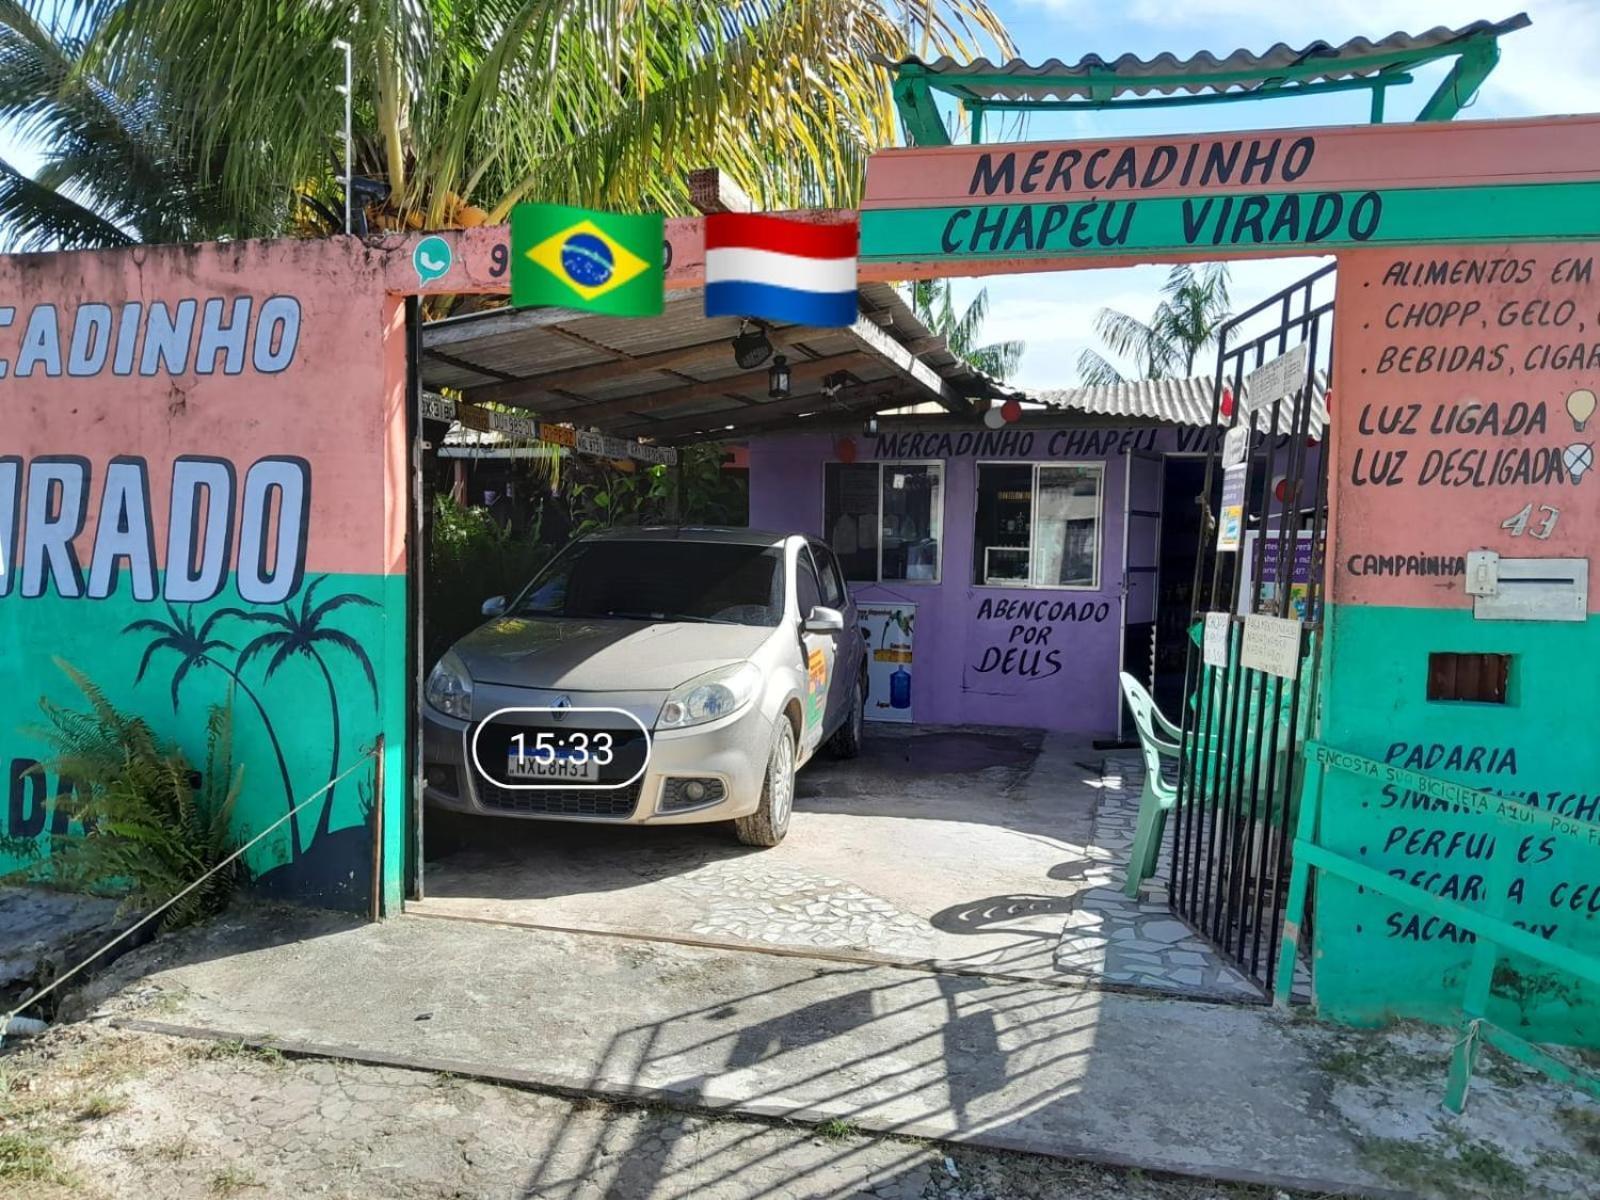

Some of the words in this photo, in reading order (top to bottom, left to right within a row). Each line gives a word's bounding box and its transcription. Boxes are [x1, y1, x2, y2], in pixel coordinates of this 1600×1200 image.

[968, 136, 1315, 196] MERCADINHO
[941, 197, 1137, 253] CHAPÉU
[1181, 191, 1382, 245] VIRADO
[1382, 258, 1536, 288] ALIMENTOS
[1551, 257, 1595, 285] EM
[1385, 300, 1488, 330] CHOPP,
[1377, 344, 1516, 376] BEBIDAS,
[1358, 403, 1422, 436] LUZ
[1430, 401, 1548, 436] LIGADA
[874, 431, 1035, 458] MERCADINHO
[1351, 448, 1408, 487] LUZ
[1417, 447, 1566, 488] DESLIGADA
[1009, 625, 1052, 645] POR
[972, 646, 1061, 681] DEUS
[1383, 742, 1518, 776] PADARIA
